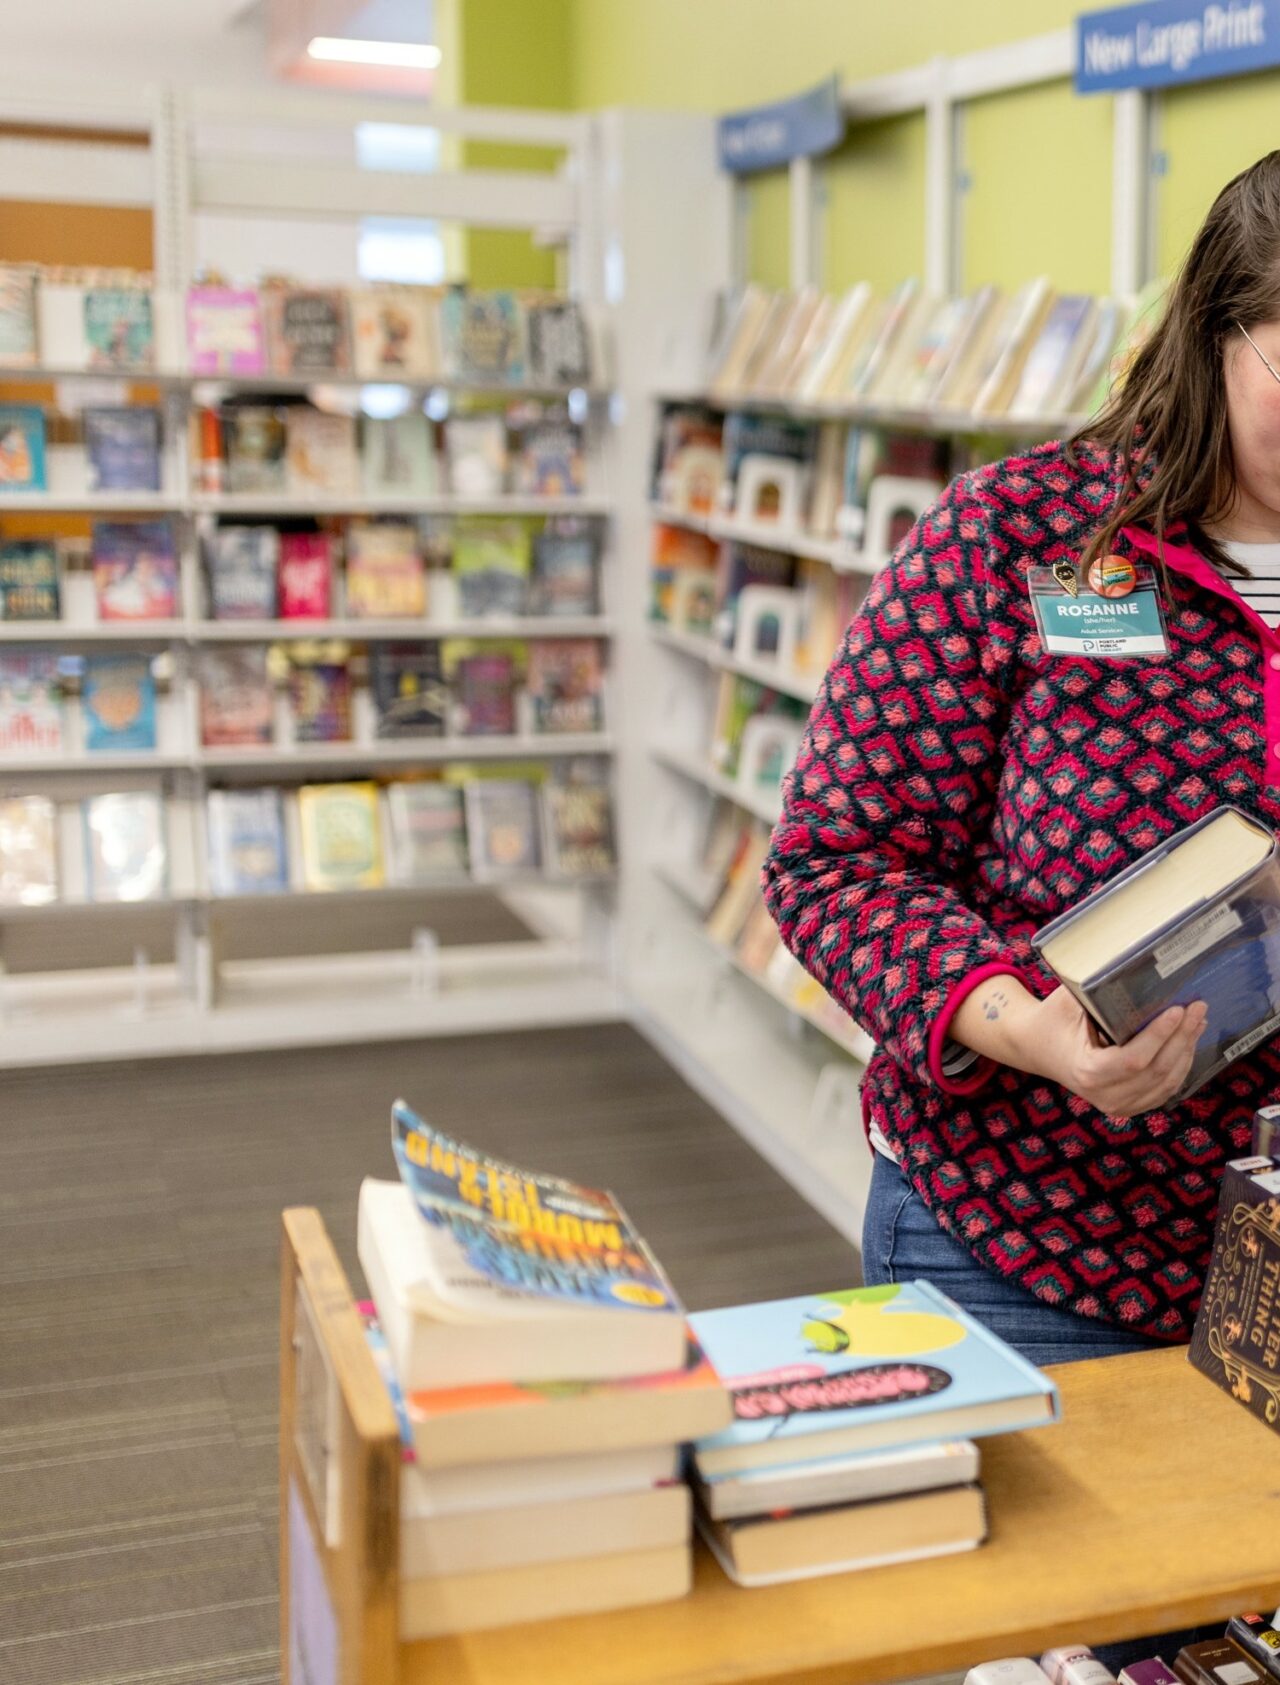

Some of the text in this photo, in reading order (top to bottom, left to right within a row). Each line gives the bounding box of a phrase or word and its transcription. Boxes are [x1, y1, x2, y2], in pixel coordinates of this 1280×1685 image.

[1084, 1, 1266, 74] New Large Print
[1057, 603, 1139, 616] ROSANNE
[1249, 1260, 1280, 1348] THING
